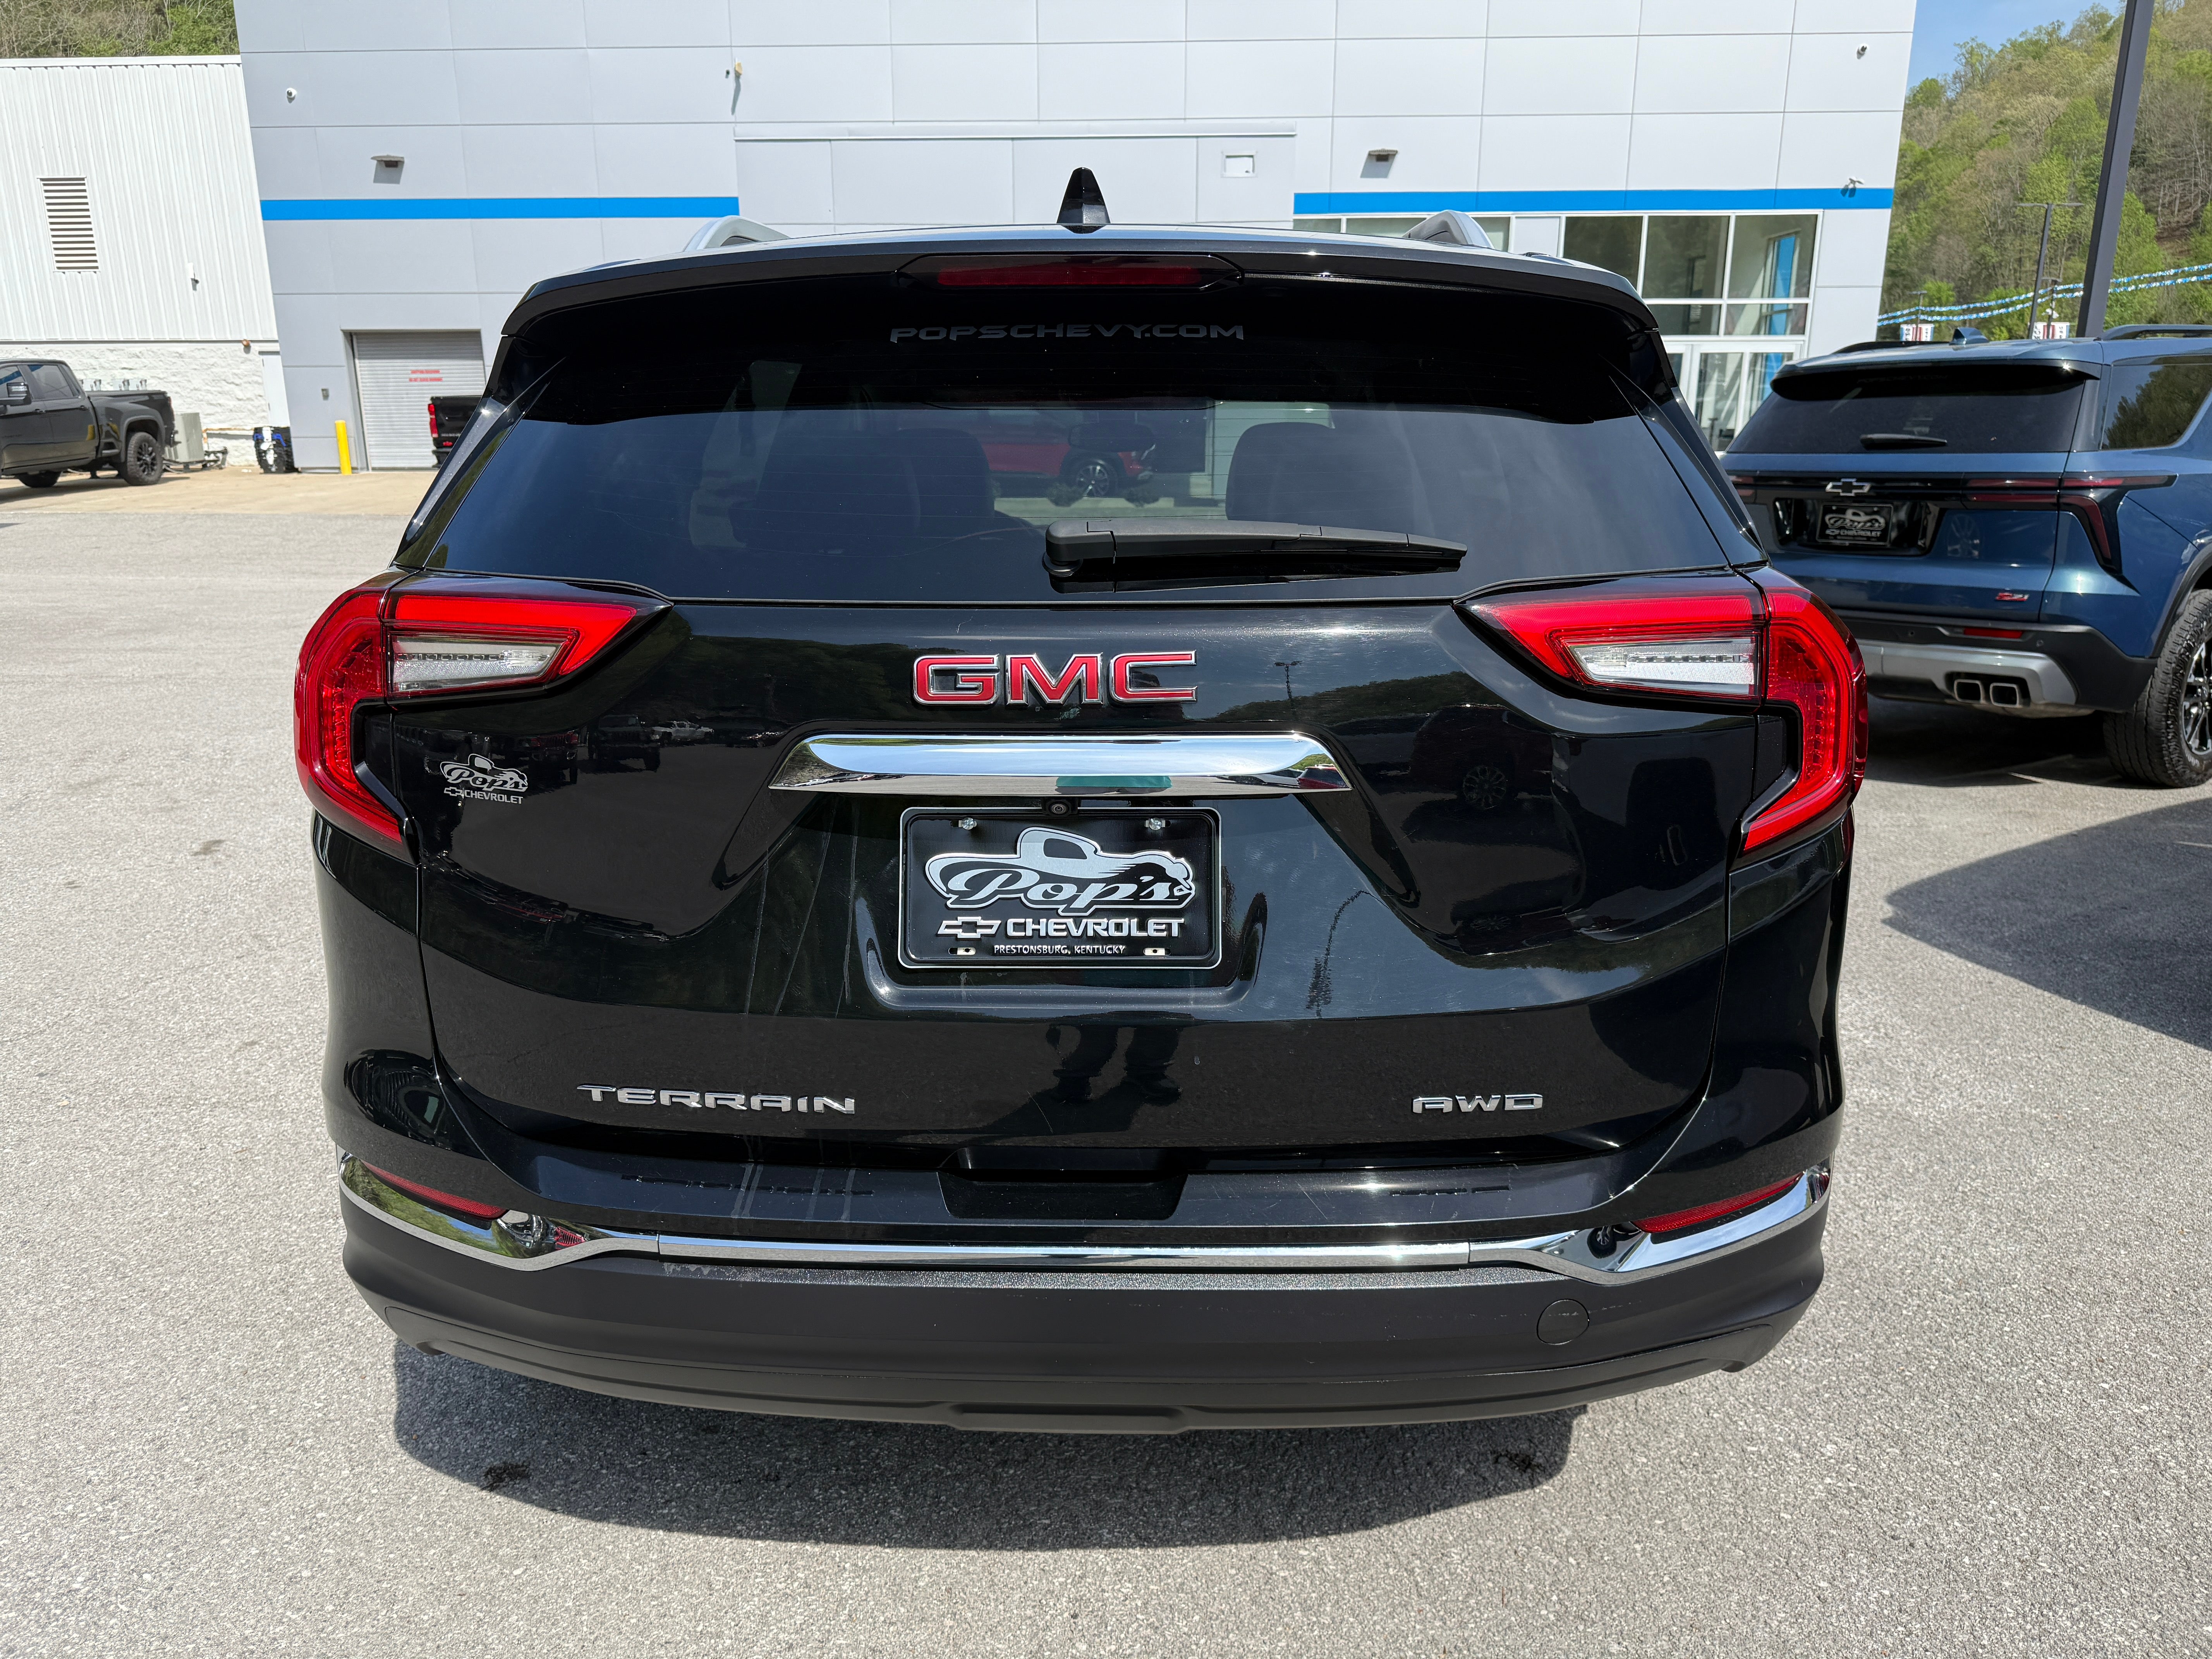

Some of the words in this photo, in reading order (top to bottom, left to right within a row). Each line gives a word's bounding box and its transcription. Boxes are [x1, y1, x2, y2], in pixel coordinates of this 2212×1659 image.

[890, 323, 1244, 343] POPSCHEVY.COM
[913, 649, 1198, 706] GMC
[446, 767, 524, 791] Pop's
[464, 790, 523, 804] CHEVROLET
[948, 867, 1179, 908] Pop's
[1007, 918, 1185, 938] CHEVROLET
[994, 945, 1071, 955] PRESTONSBURG,
[1074, 945, 1125, 954] KENTUCKY
[577, 1083, 856, 1115] TERRAIN
[1412, 1093, 1544, 1114] AWD
